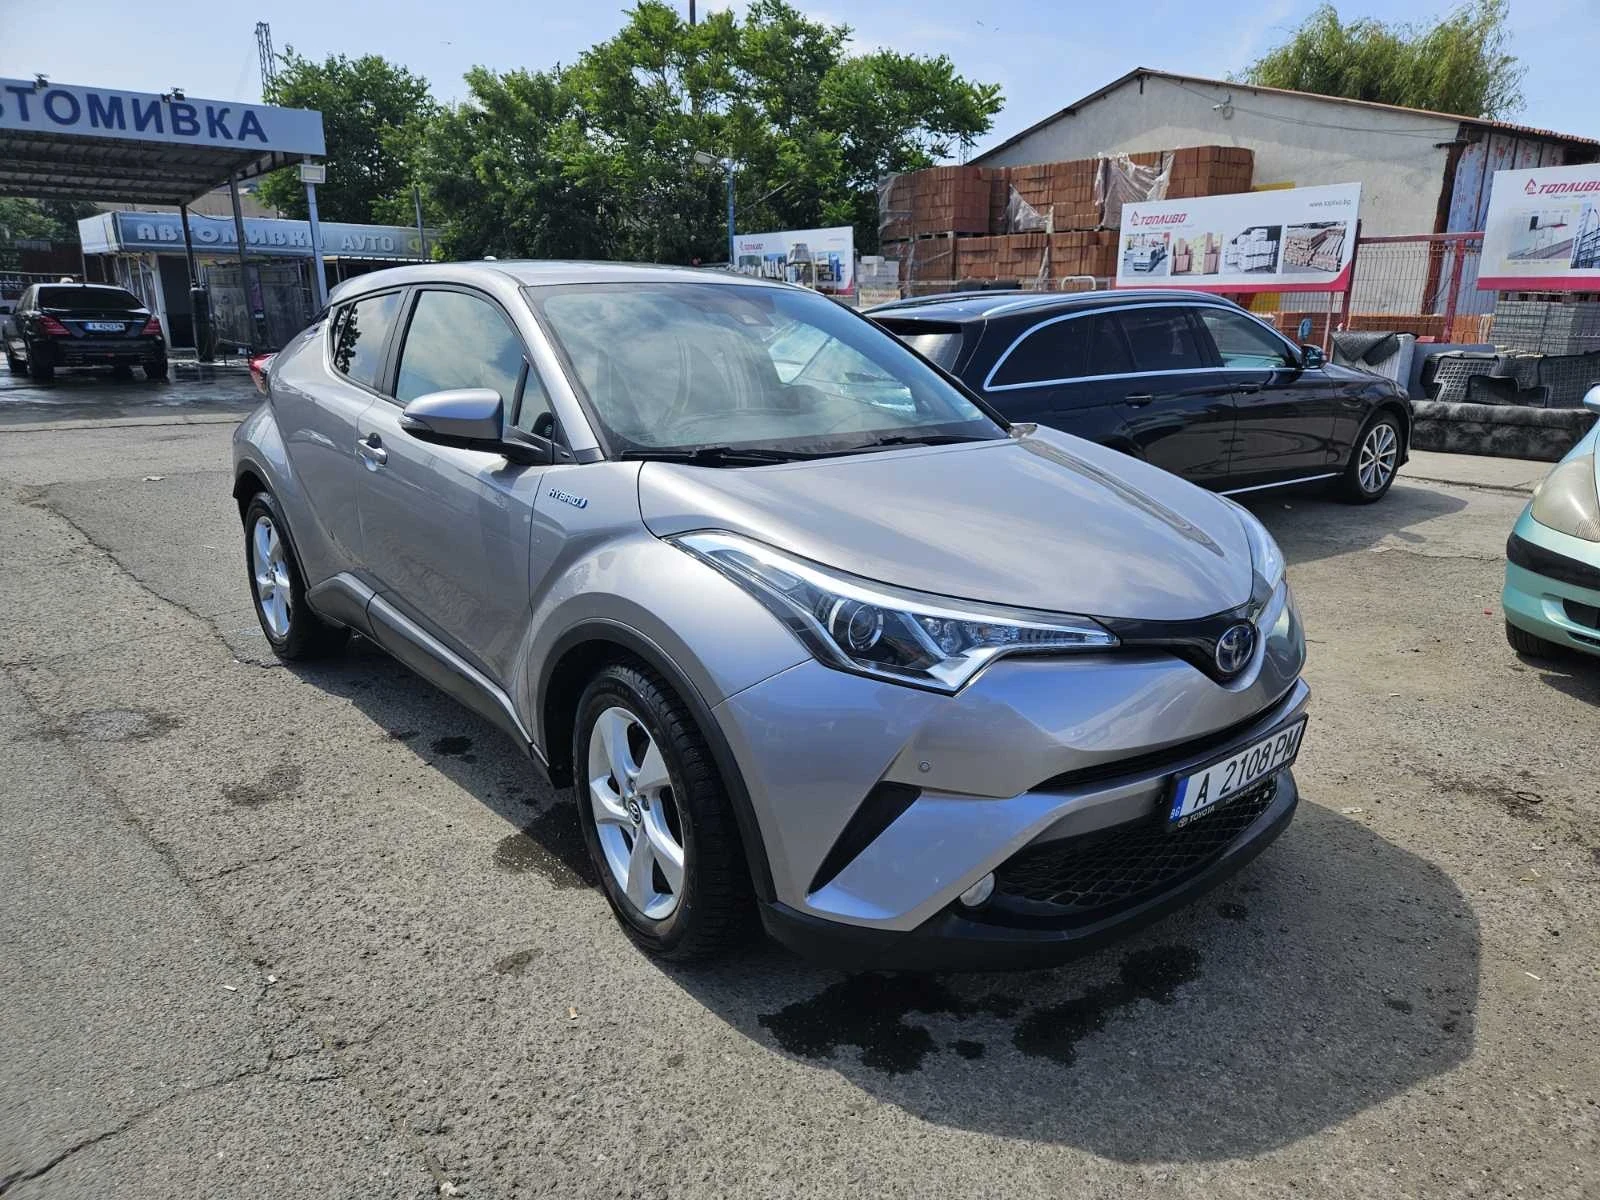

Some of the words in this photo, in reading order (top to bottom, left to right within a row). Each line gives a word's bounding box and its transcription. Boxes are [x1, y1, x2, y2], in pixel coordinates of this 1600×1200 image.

[0, 86, 268, 143] ТОМИВКА
[1194, 773, 1210, 809] A
[1169, 806, 1181, 820] BG
